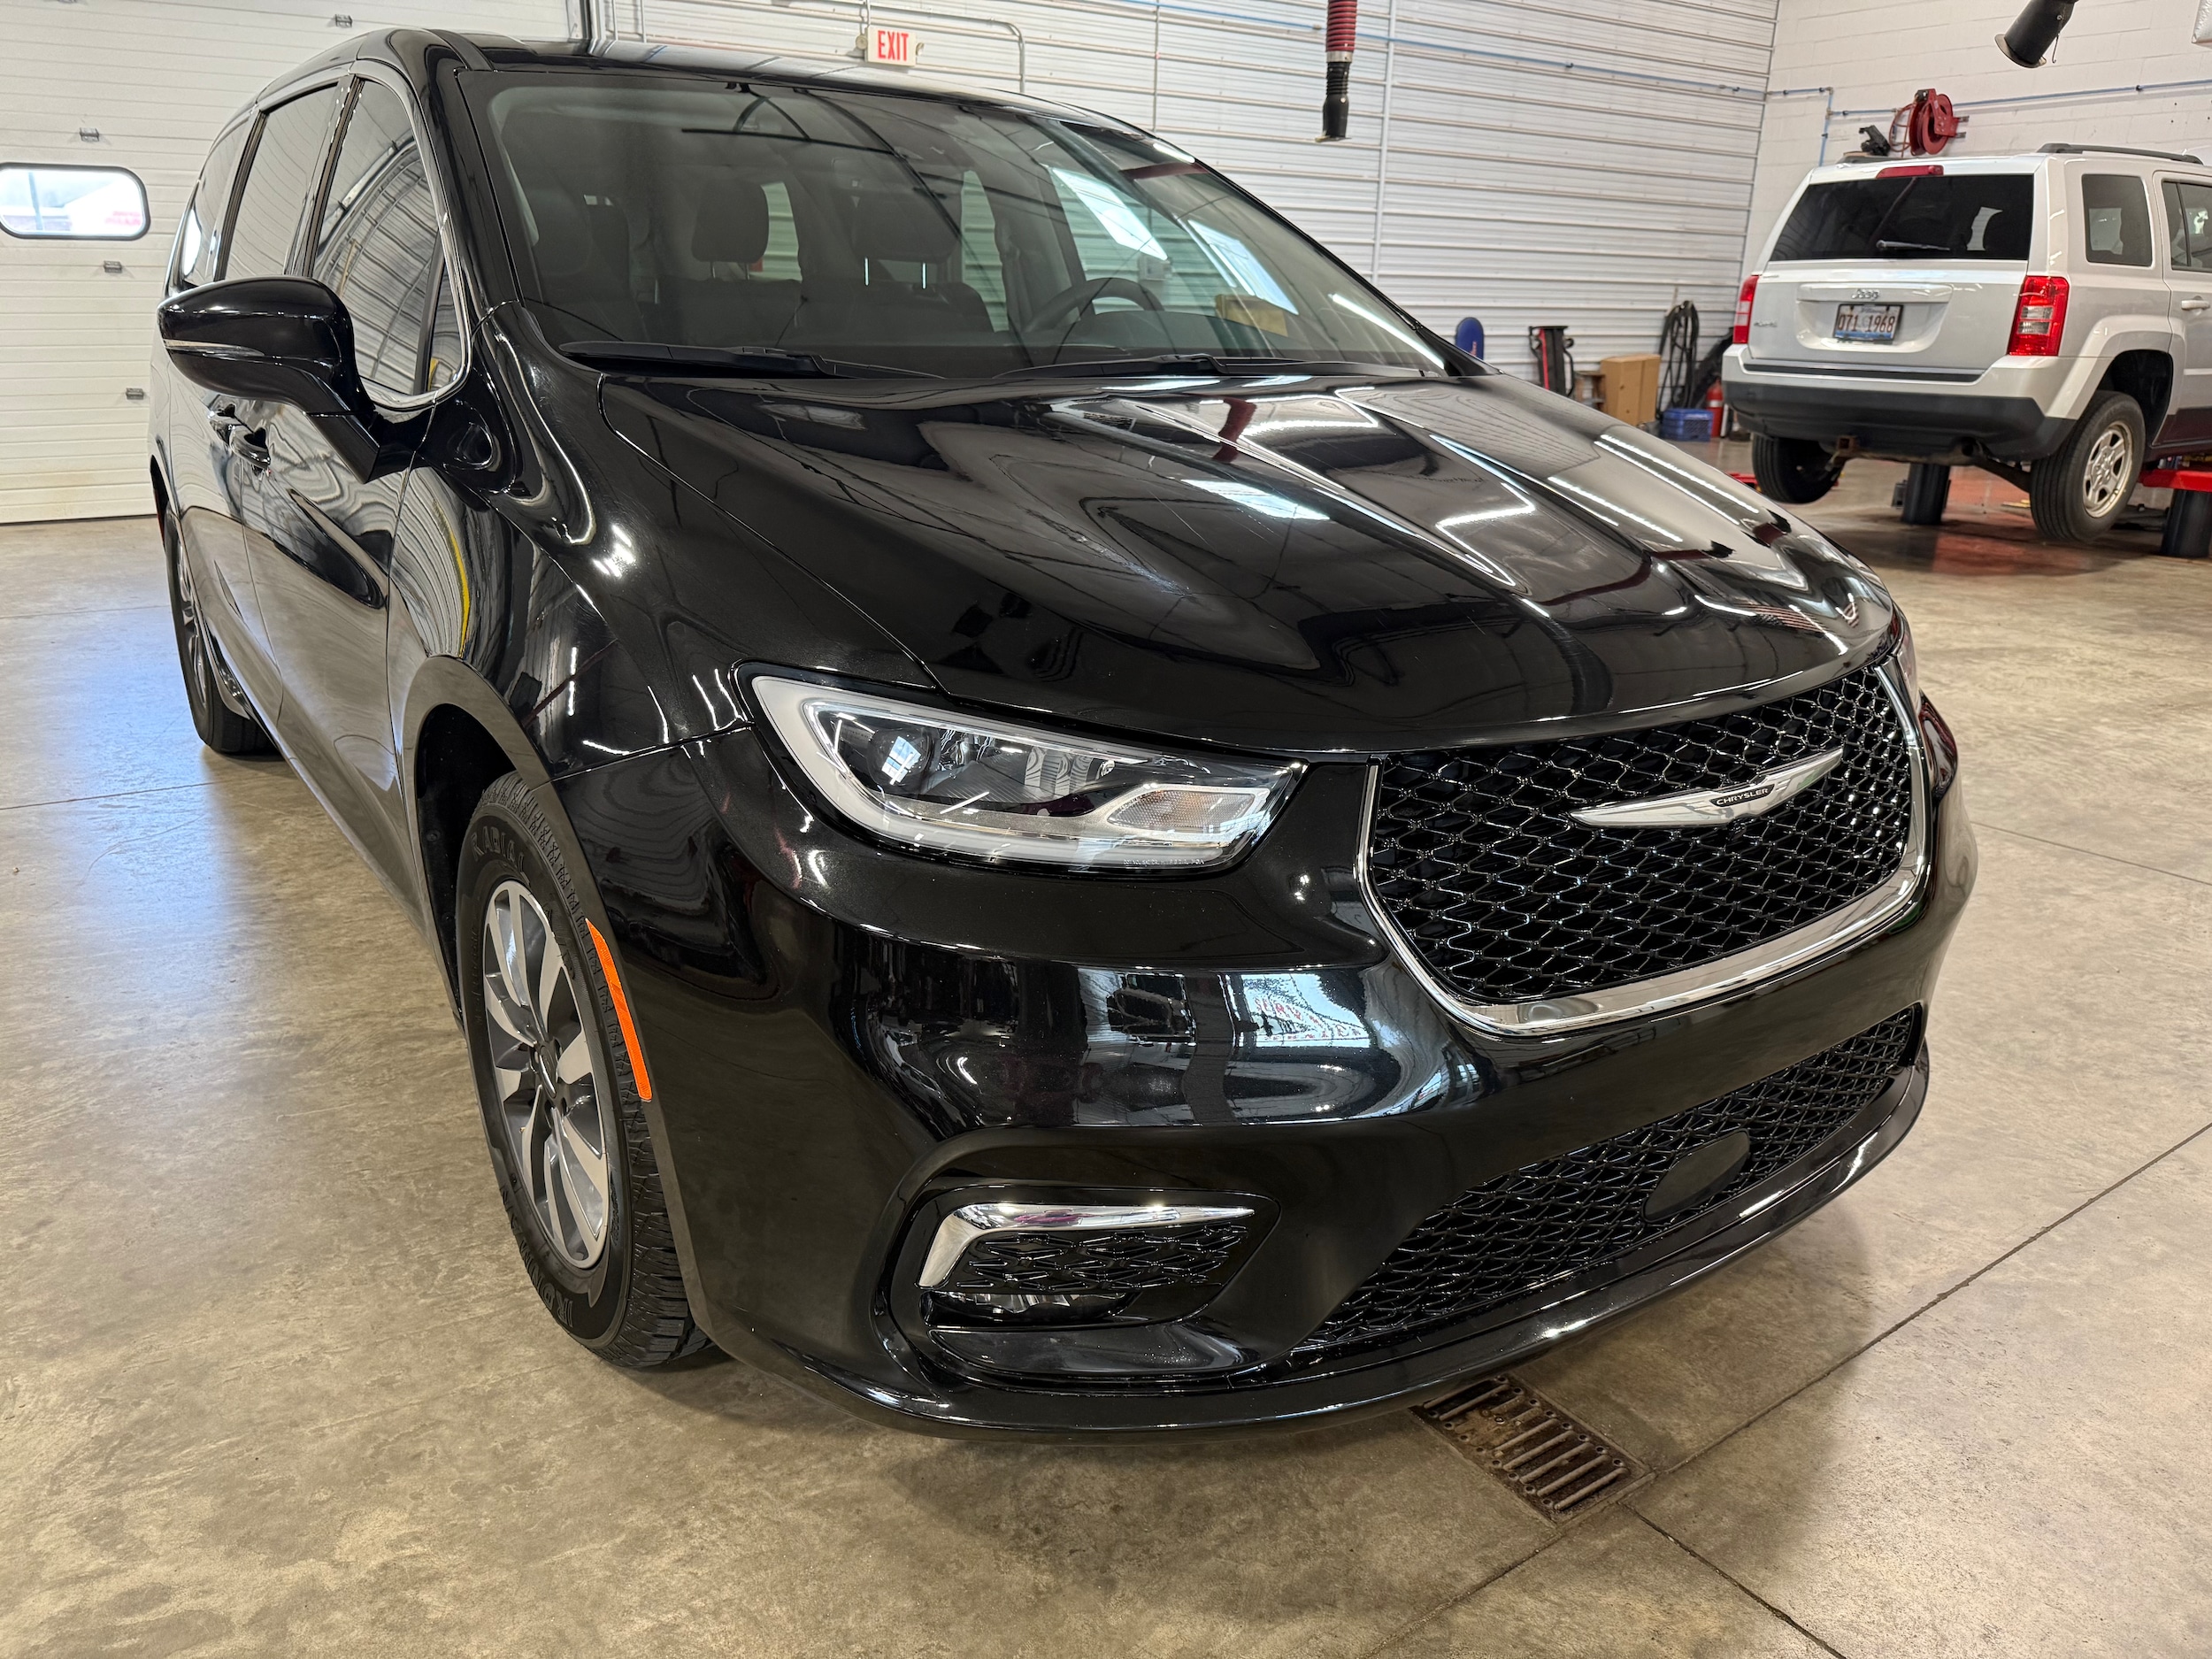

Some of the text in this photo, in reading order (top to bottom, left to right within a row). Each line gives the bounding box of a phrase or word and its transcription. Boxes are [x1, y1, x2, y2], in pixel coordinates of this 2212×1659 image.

[878, 30, 909, 61] EXIT
[1852, 288, 1879, 301] Jeep
[1865, 315, 1895, 333] 1968
[1717, 788, 1769, 805] CHRYSLER
[470, 826, 531, 887] RADIAL
